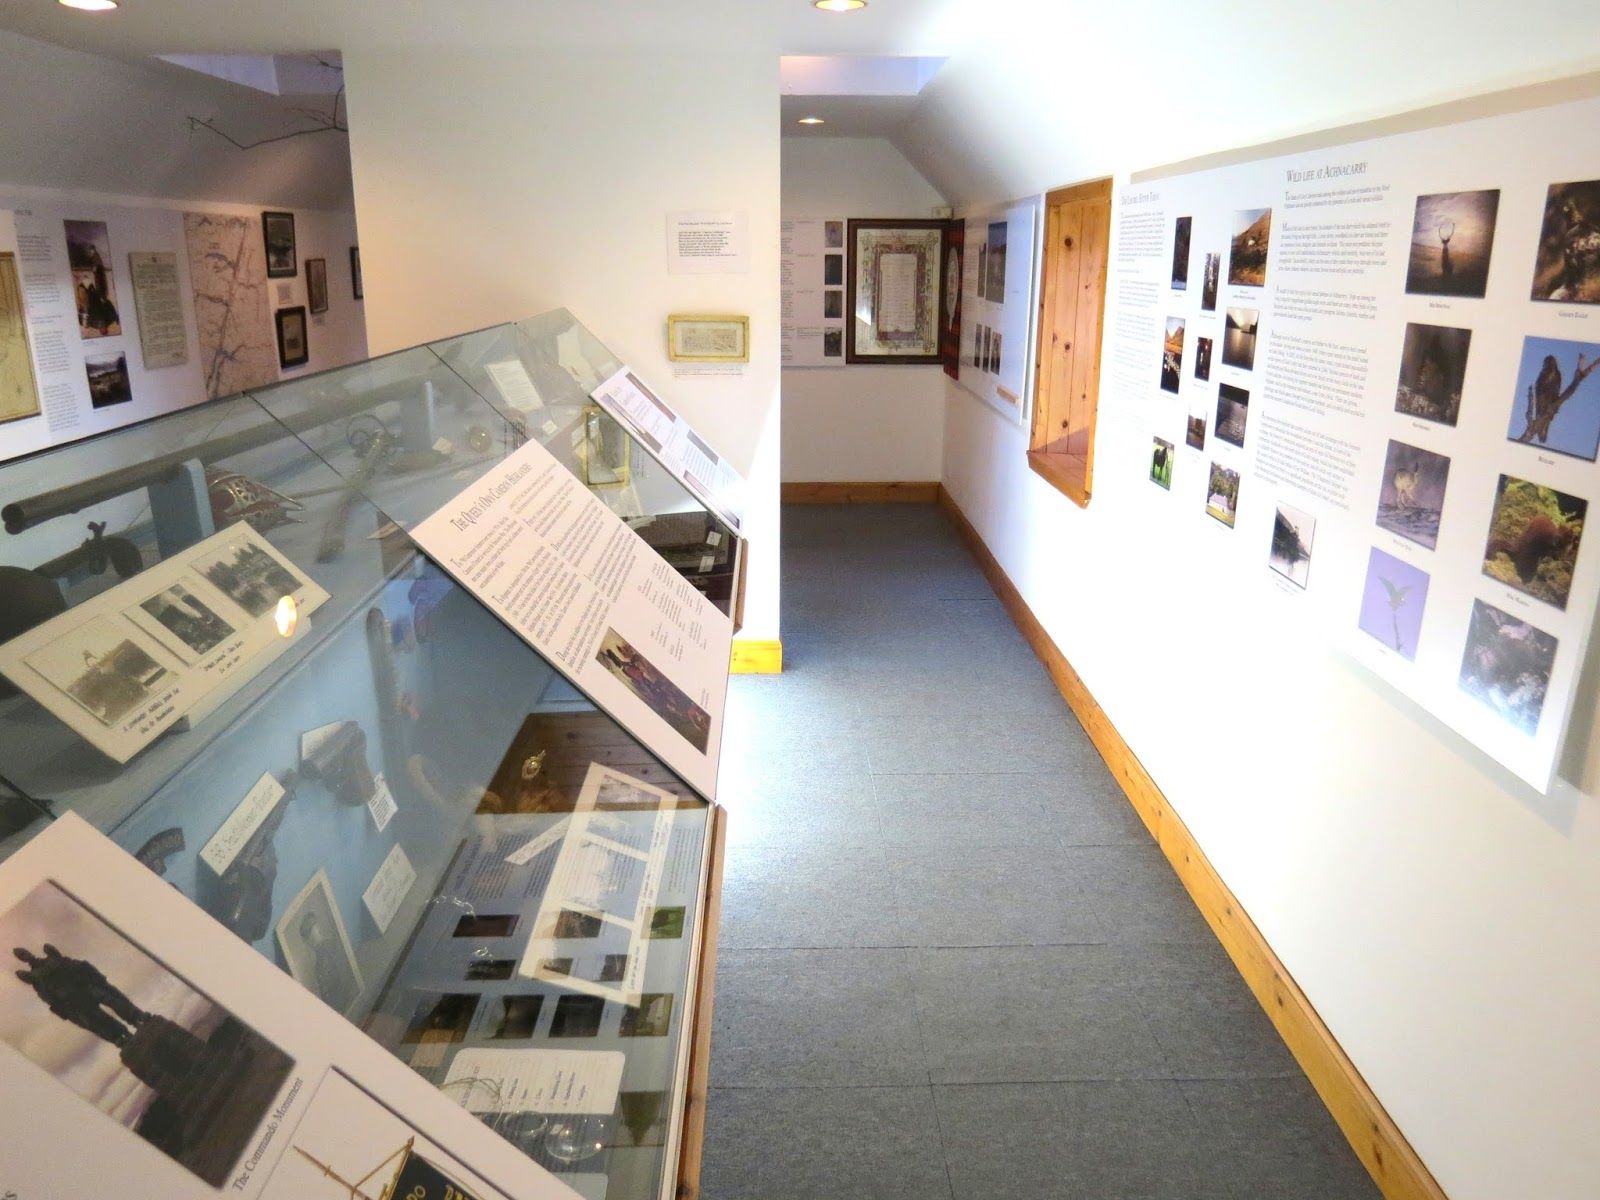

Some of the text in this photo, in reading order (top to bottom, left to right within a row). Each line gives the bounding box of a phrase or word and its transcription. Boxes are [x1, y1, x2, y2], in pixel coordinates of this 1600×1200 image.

[231, 1077, 304, 1191] The Commando Monument
